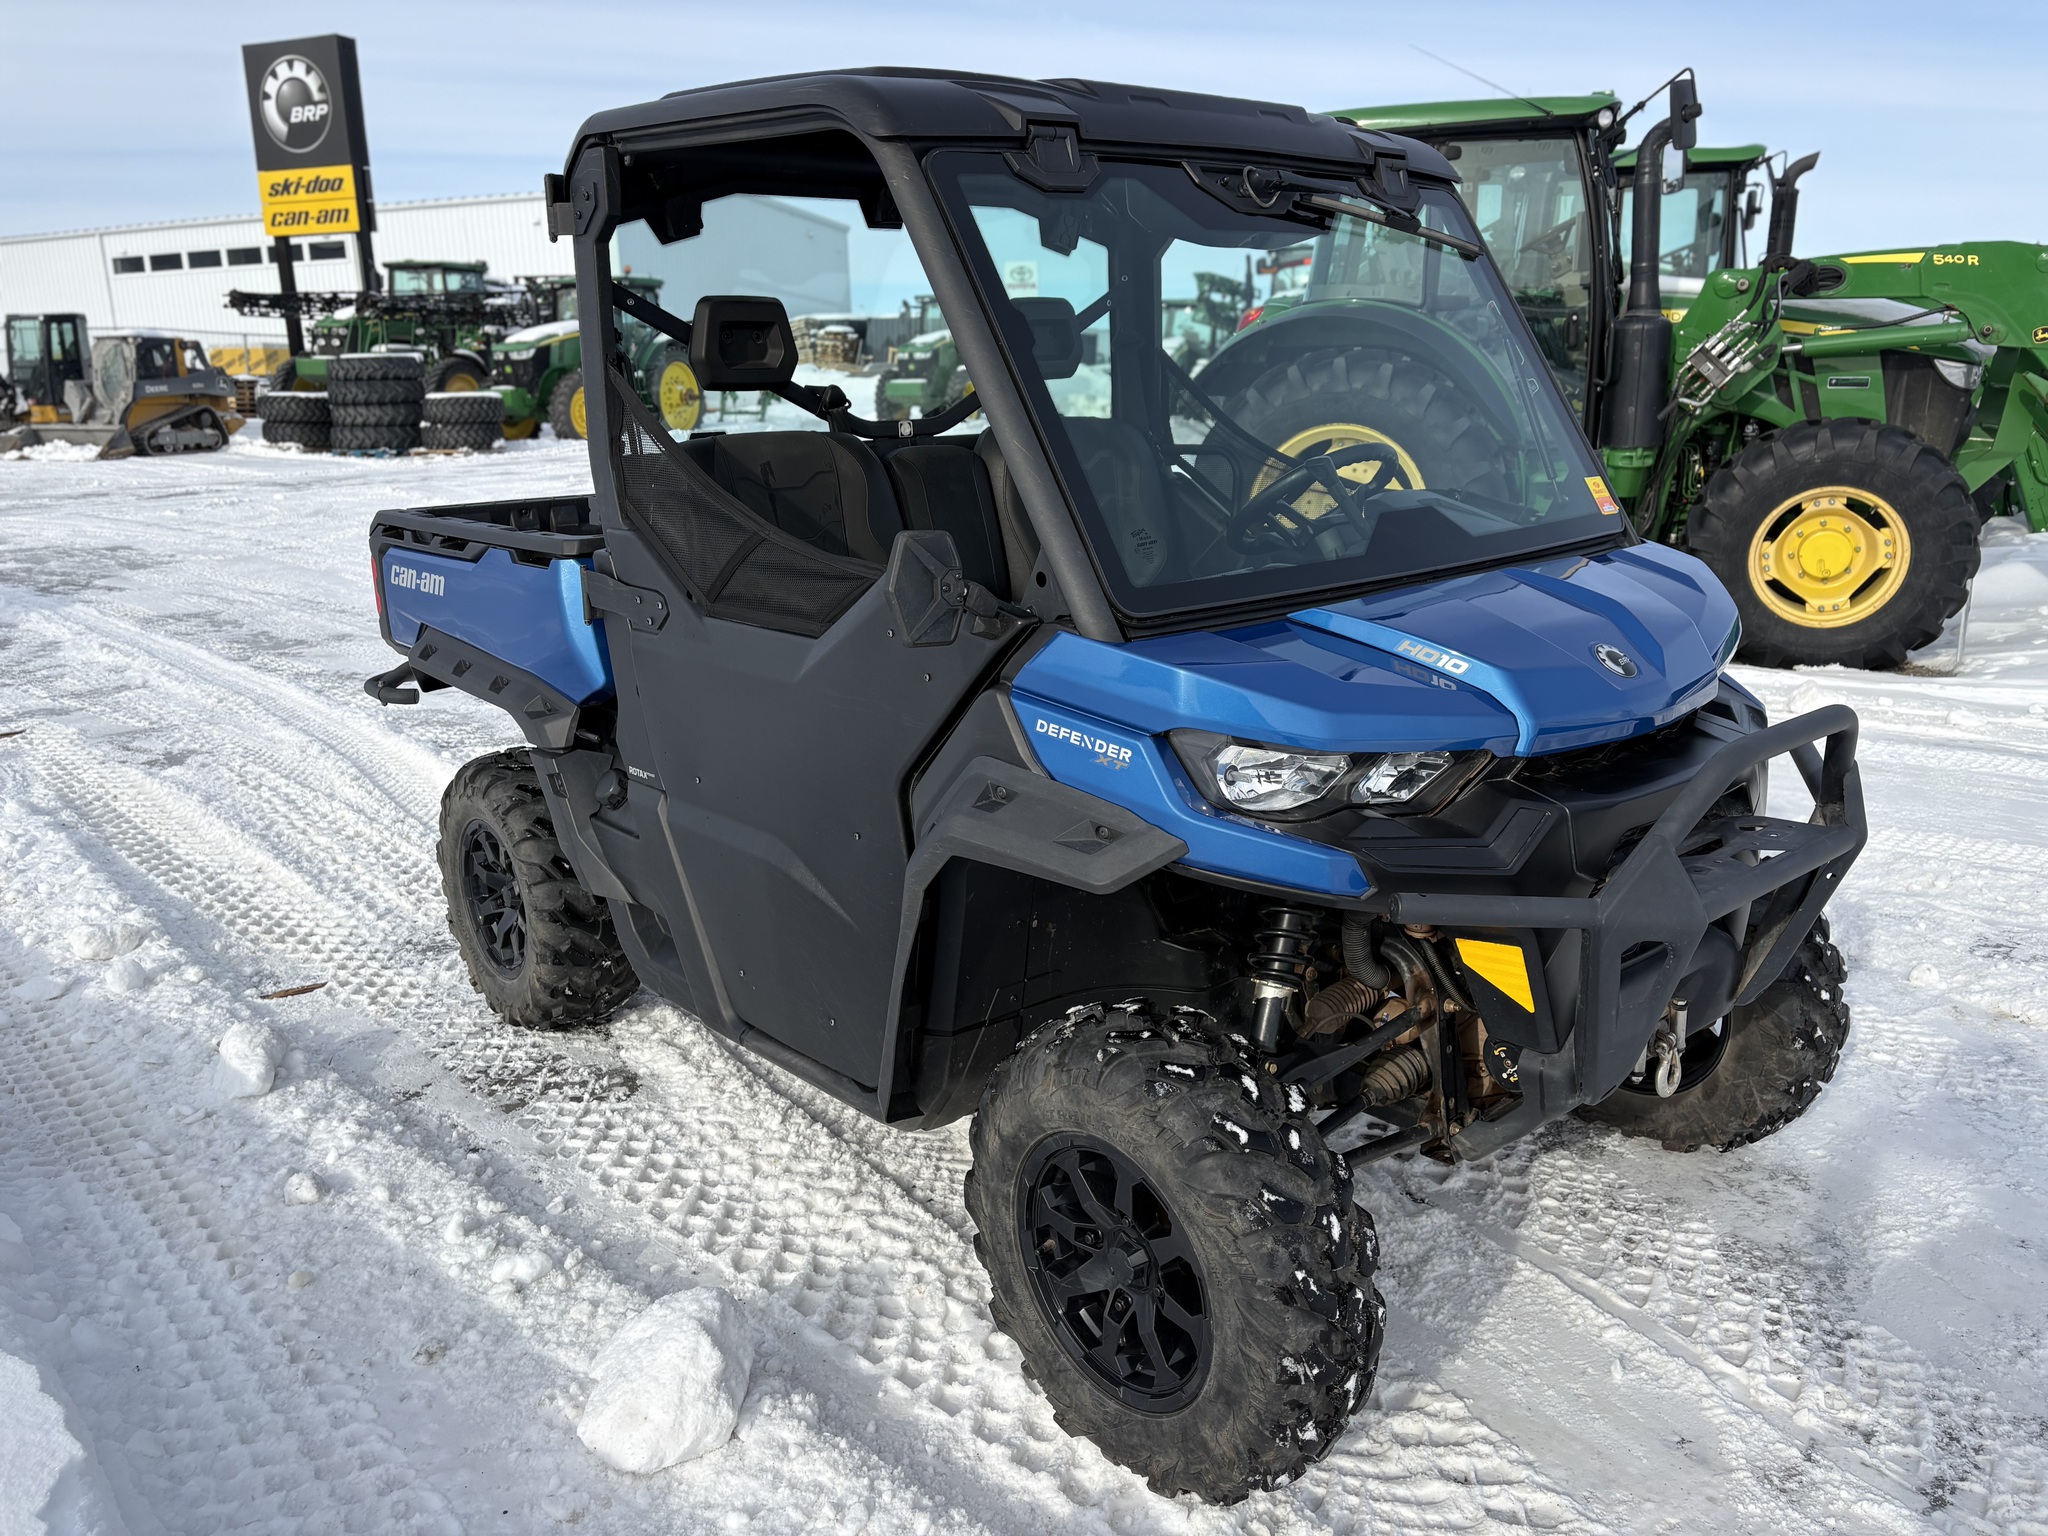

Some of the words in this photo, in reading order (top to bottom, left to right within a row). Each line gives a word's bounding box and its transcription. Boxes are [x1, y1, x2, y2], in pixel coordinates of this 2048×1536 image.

[290, 103, 329, 123] BRP
[268, 175, 344, 198] ski-doo
[271, 208, 350, 228] can-am
[1933, 254, 1965, 265] 540
[390, 564, 445, 597] can-am
[1397, 640, 1470, 674] HD10
[1036, 719, 1132, 762] DEFENDER
[628, 765, 648, 779] ROTAX
[1094, 754, 1129, 770] XT
